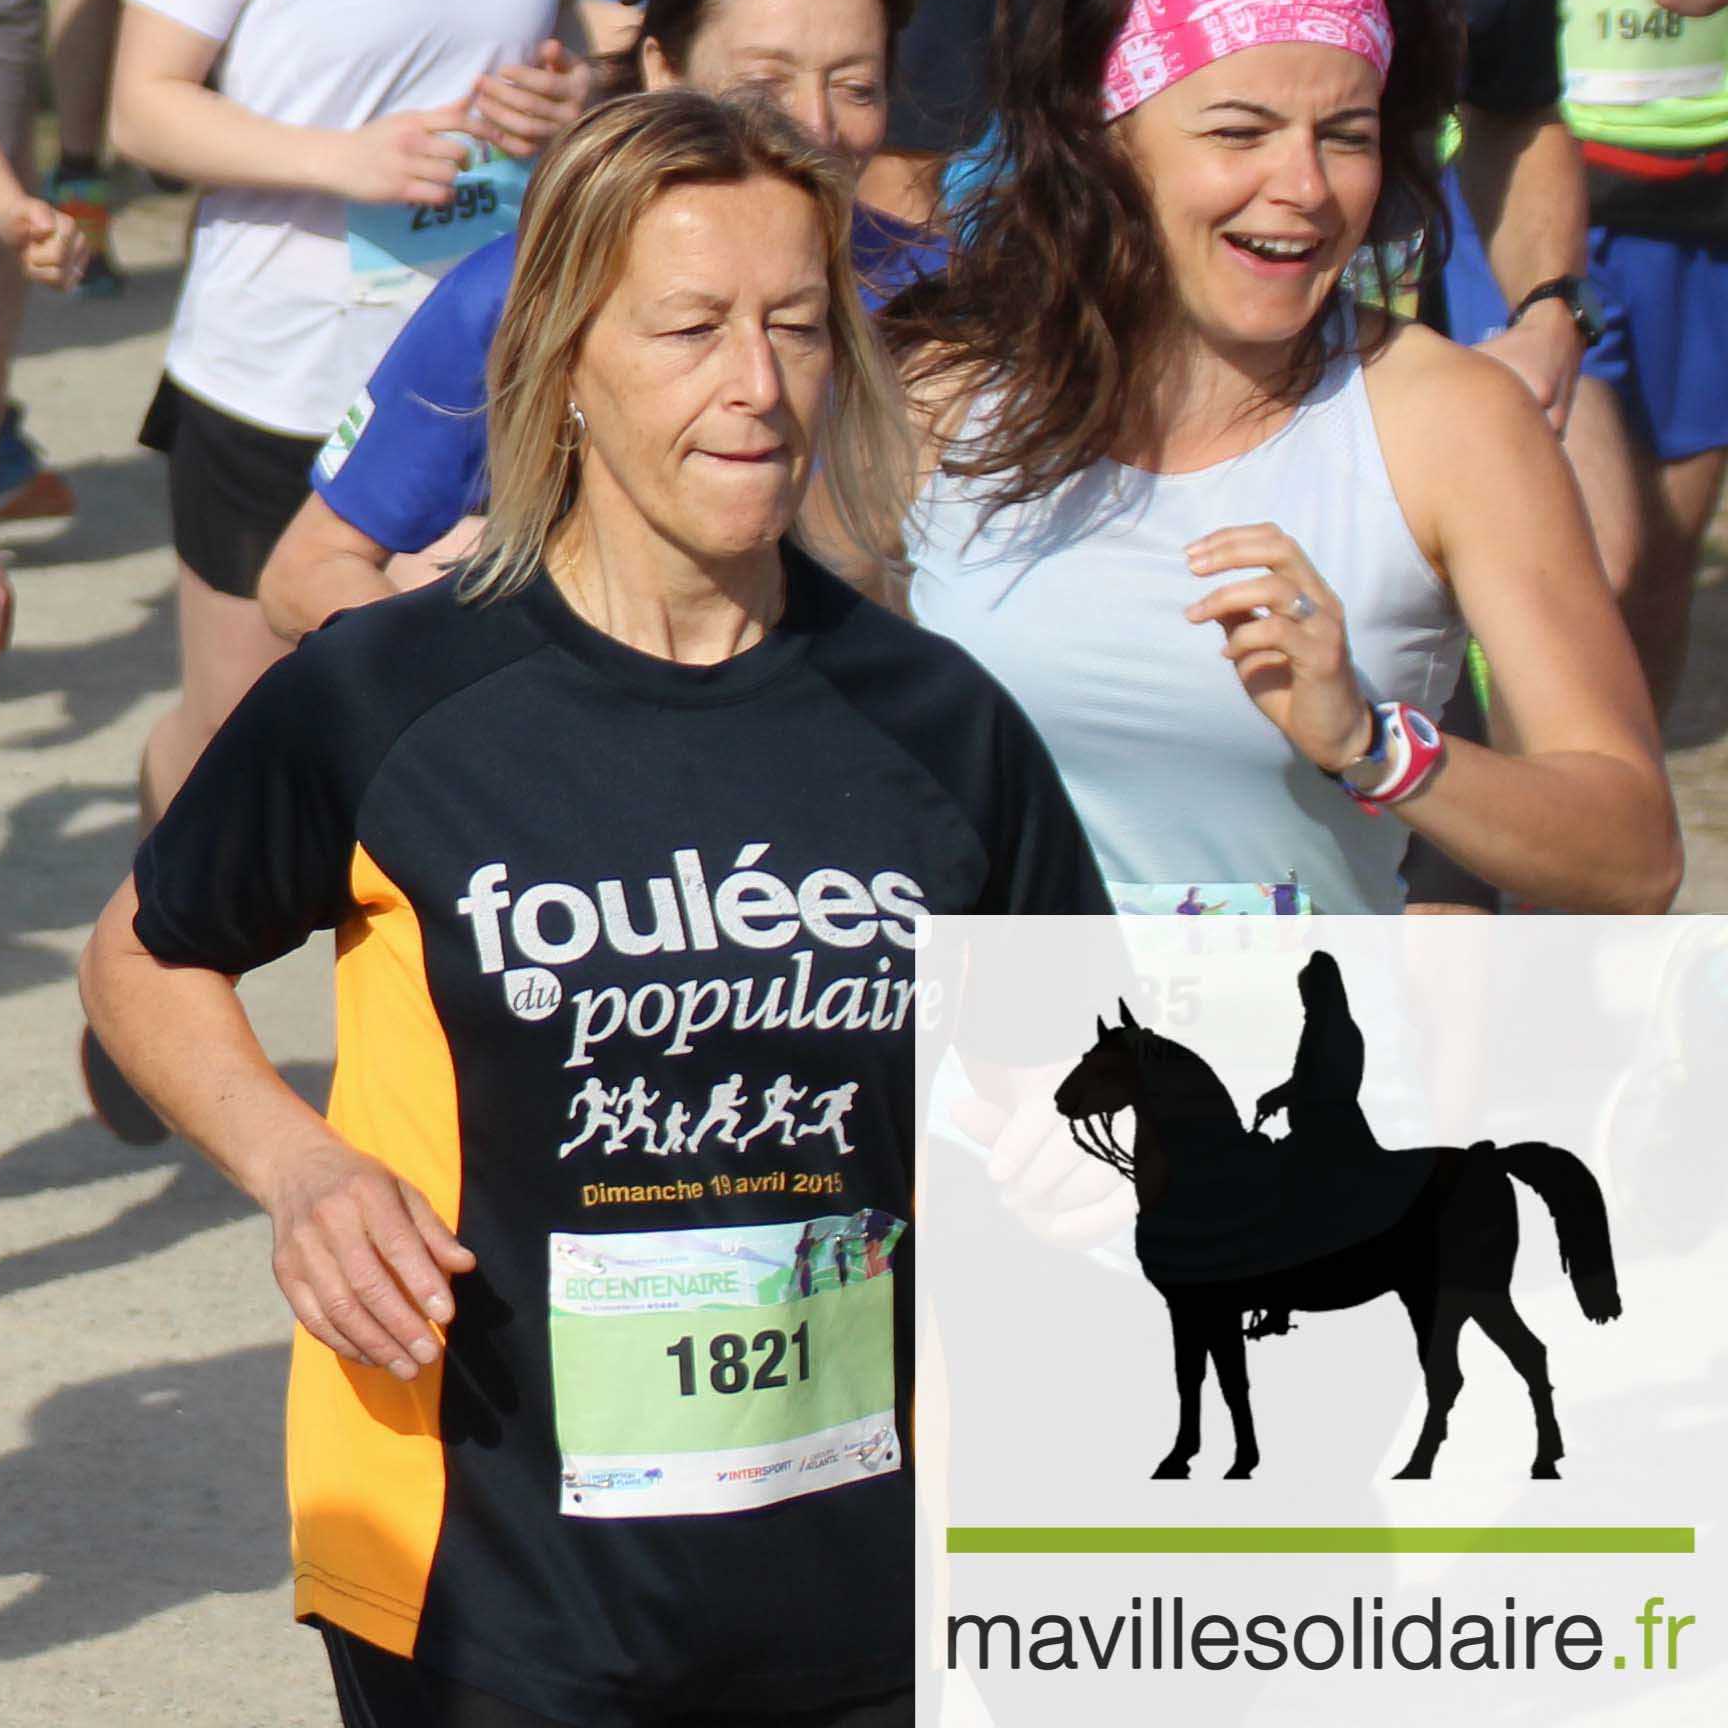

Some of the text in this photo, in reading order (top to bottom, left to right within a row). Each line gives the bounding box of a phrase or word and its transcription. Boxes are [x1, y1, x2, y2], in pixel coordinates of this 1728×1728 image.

[1596, 8, 1681, 41] 1948
[457, 843, 932, 974] foulées
[513, 949, 945, 1069] du populaire
[582, 1171, 843, 1208] Dimanche 19 avril 2015
[565, 1269, 741, 1301] BICENTENAIRE
[666, 1320, 813, 1398] 1821
[728, 1459, 793, 1483] INTERSPORT
